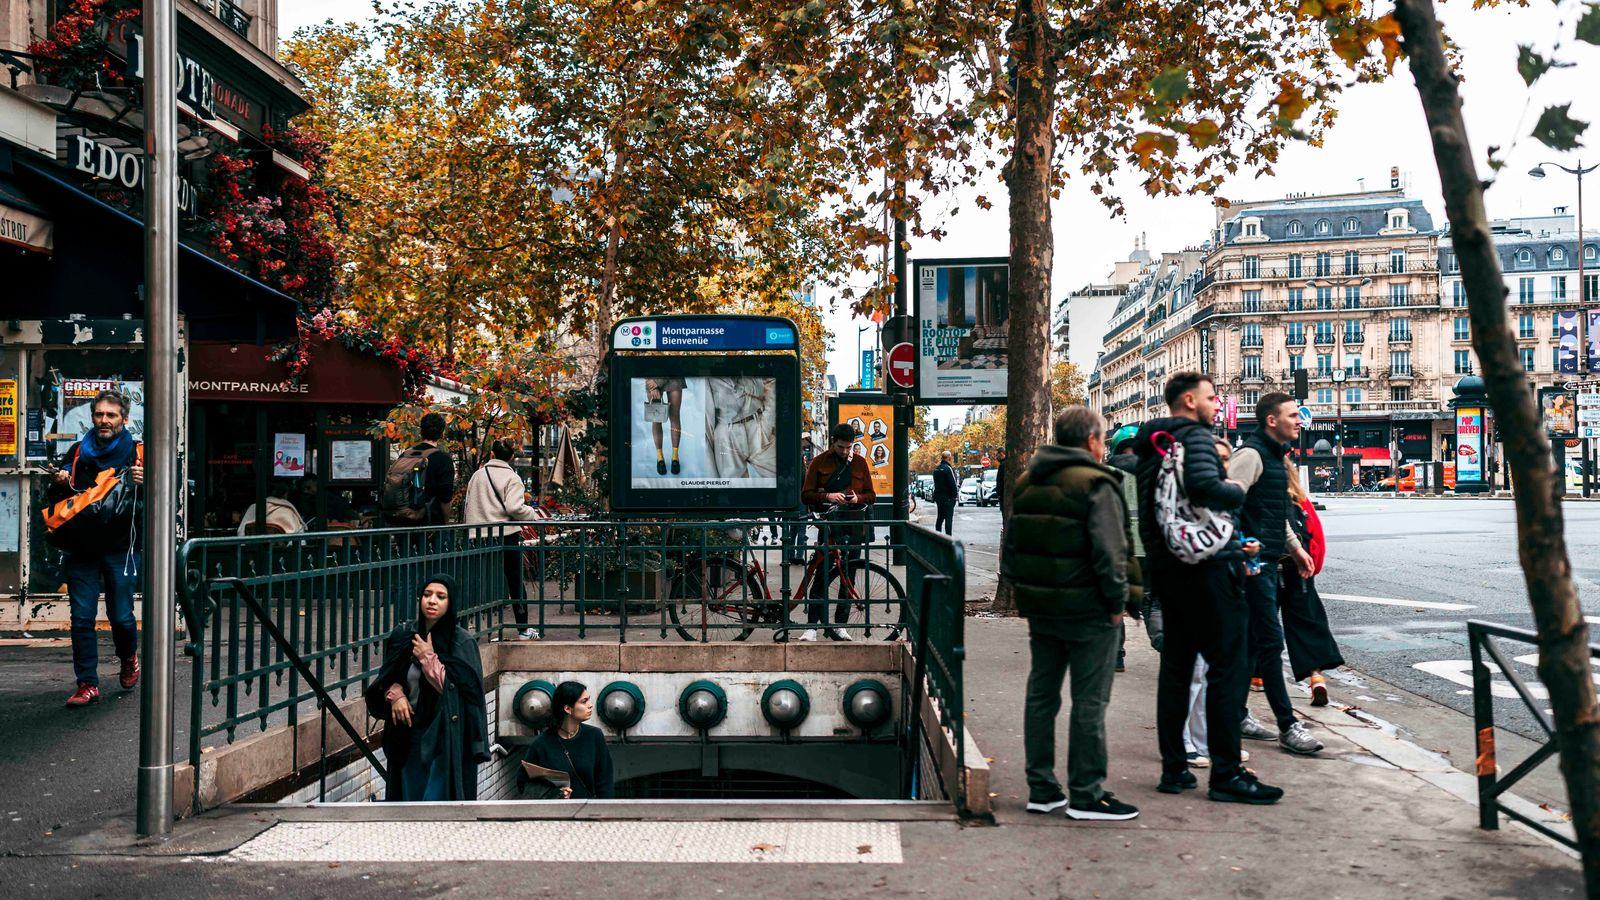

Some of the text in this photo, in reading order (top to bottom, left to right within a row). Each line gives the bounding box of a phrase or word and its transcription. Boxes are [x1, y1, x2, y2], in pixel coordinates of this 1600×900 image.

[1, 217, 27, 241] STROT
[922, 320, 932, 329] LE
[662, 326, 725, 336] Montparnasse
[922, 328, 967, 338] ROOFTOP
[662, 336, 709, 345] Bienvenüe
[922, 337, 959, 347] LE PLUS
[922, 347, 957, 357] EN VUE
[64, 382, 112, 391] GOSPEL
[1462, 416, 1474, 425] POP
